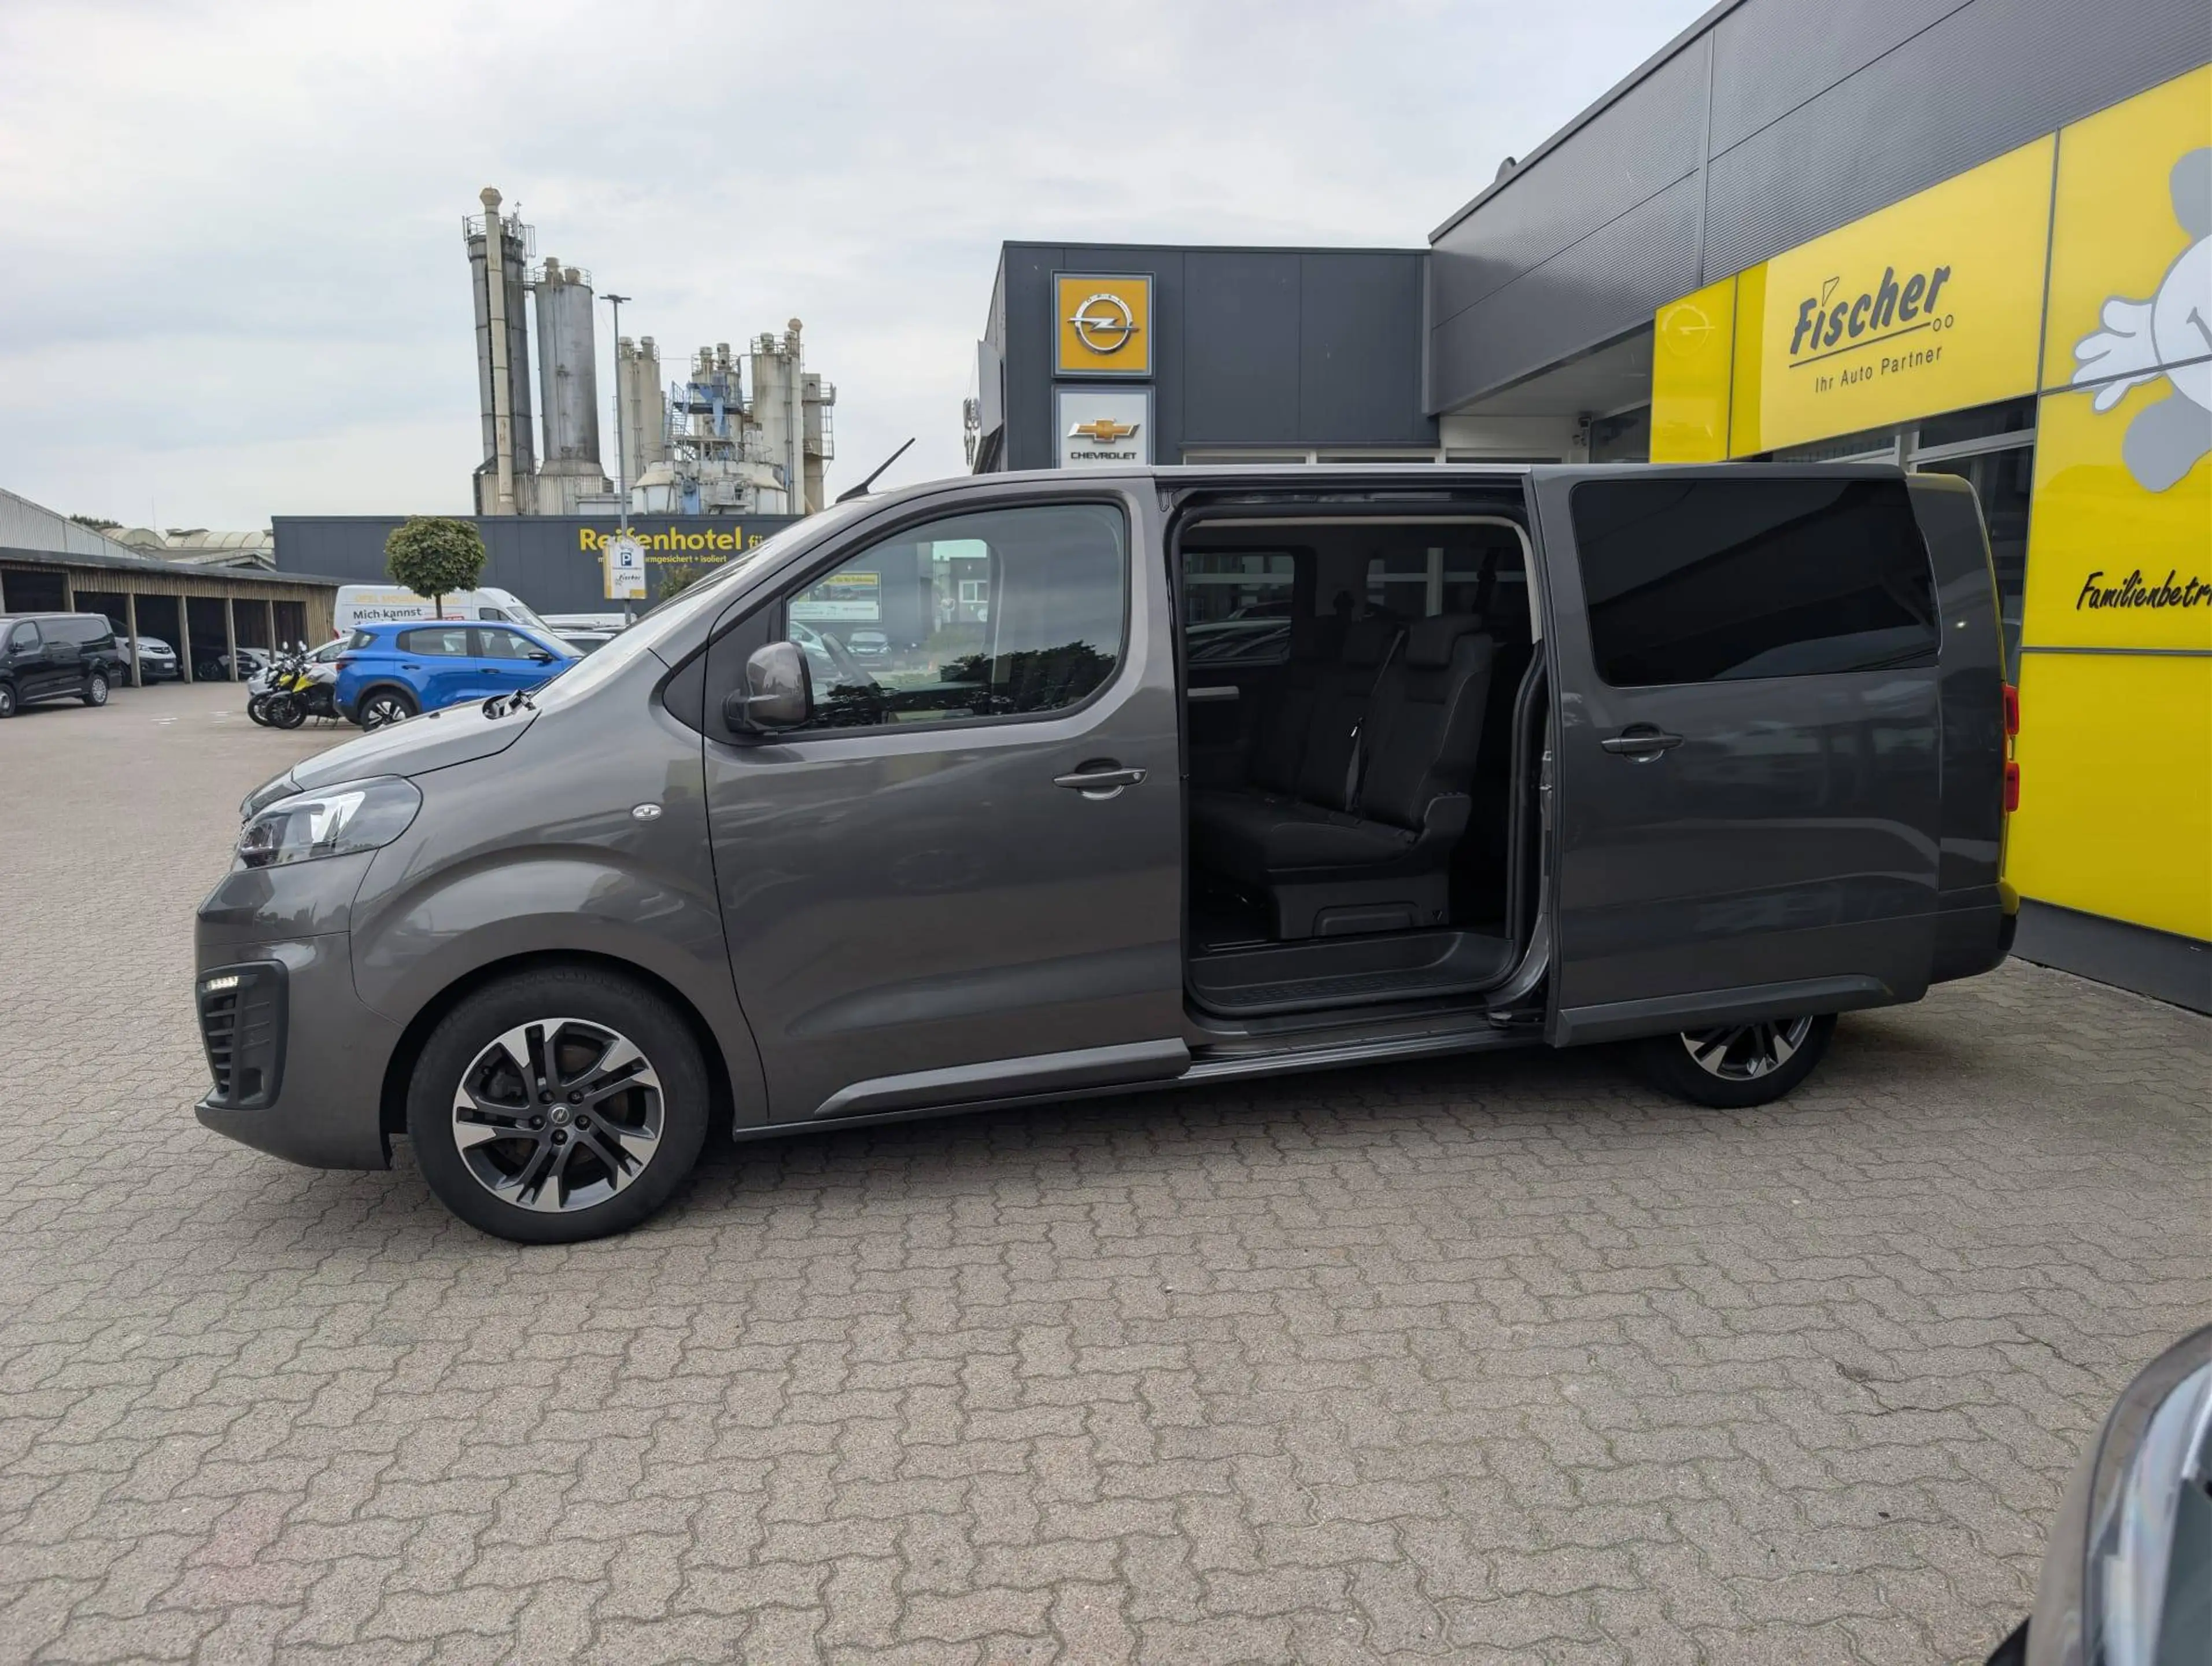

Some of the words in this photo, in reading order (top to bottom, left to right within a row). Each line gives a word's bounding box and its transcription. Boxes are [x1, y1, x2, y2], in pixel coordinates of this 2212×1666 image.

[1790, 266, 1950, 355] Fischer
[1815, 375, 1834, 393] Ihr
[1841, 366, 1873, 387] Auto
[1881, 345, 1943, 375] Partner
[1070, 452, 1137, 460] CHEVROLET
[748, 534, 763, 549] fü
[622, 552, 632, 566] P
[700, 555, 727, 563] isoliert
[353, 609, 380, 619] Mich
[383, 607, 422, 618] kannst
